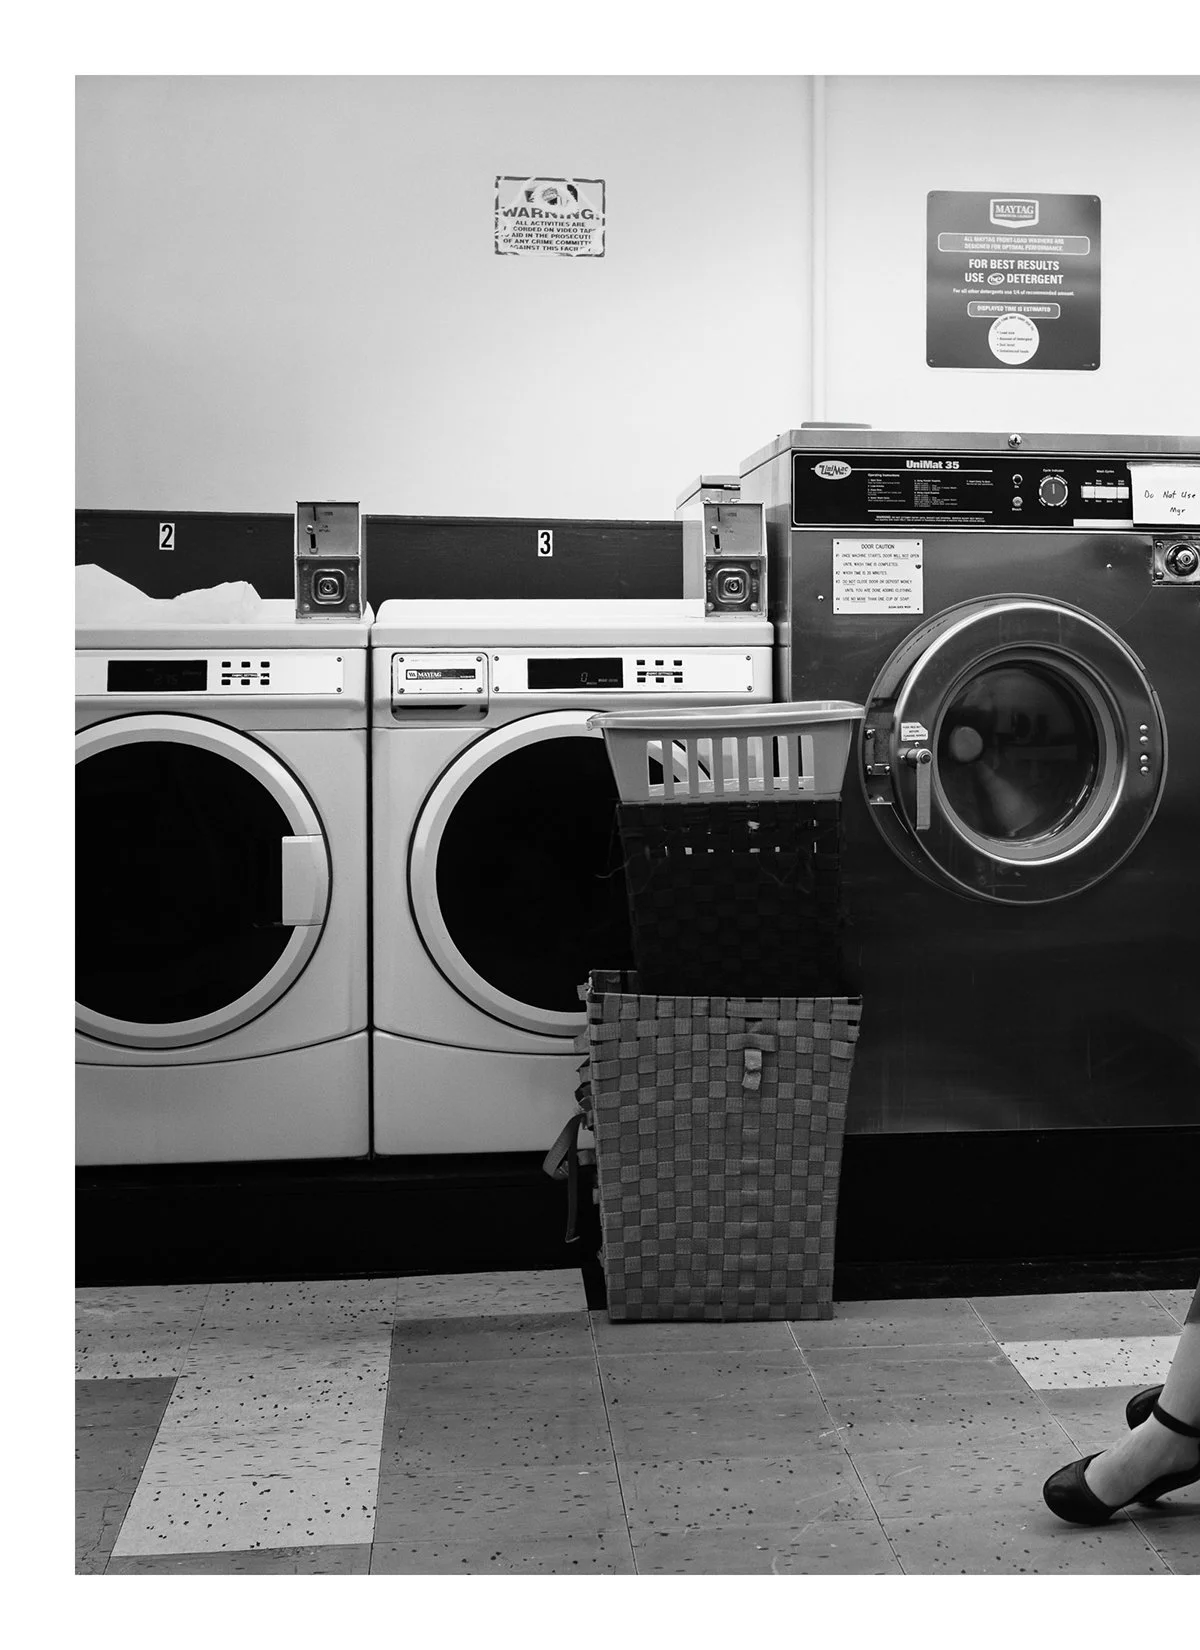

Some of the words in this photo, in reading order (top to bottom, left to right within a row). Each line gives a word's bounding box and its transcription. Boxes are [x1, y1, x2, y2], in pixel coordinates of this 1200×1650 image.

[995, 204, 1034, 214] MAYTAG
[969, 259, 988, 269] FOR
[990, 259, 1015, 270] BEST
[1017, 260, 1060, 271] RESULTS
[965, 273, 984, 283] USE
[1007, 274, 1064, 285] DETERGENT
[906, 460, 943, 469] UniMat
[945, 460, 960, 469] 35
[1144, 490, 1154, 498] Do
[1162, 490, 1176, 499] Not
[1181, 491, 1196, 499] Use
[1169, 506, 1186, 515] Mgr
[161, 524, 173, 548] 2
[540, 532, 551, 554] 3
